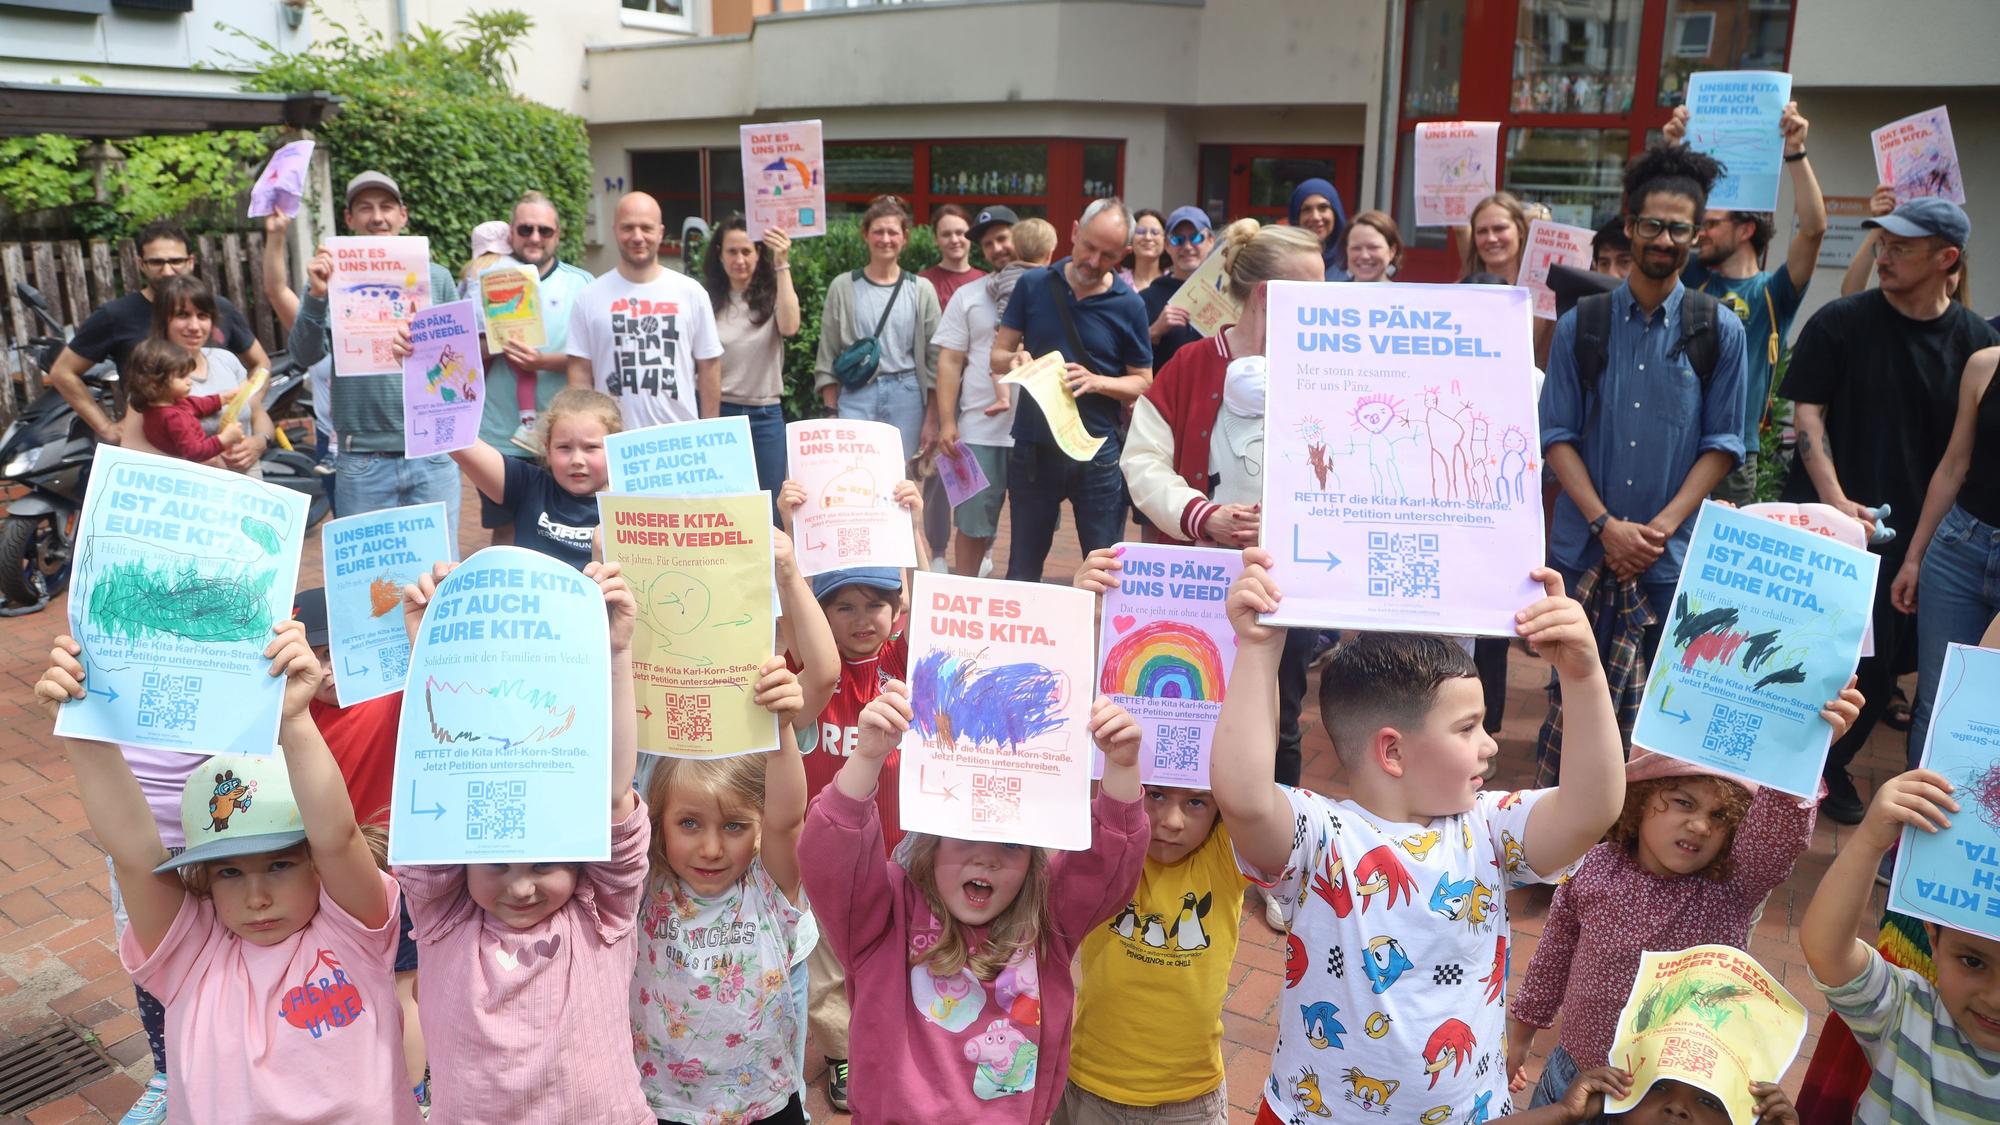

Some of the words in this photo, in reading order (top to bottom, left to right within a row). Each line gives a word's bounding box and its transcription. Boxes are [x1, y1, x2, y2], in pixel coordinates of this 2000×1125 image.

[1700, 83, 1748, 92] UNSERE
[1752, 82, 1779, 92] KITA
[1698, 94, 1718, 102] IST
[1720, 94, 1755, 103] AUCH
[1696, 106, 1728, 114] EURE
[752, 134, 773, 144] DAT
[776, 133, 789, 142] ES
[1424, 130, 1448, 139] UNS
[1880, 130, 1897, 142] DAT
[1900, 123, 1914, 134] ES
[752, 146, 774, 154] UNS
[1881, 139, 1902, 150] UNS
[1536, 228, 1556, 236] DAT
[1558, 231, 1570, 239] ES
[338, 248, 364, 258] DAT
[368, 248, 386, 258] ES
[339, 262, 368, 272] UNS
[371, 262, 406, 272] KITA.
[1298, 307, 1360, 327] UNS
[1369, 306, 1462, 334] PÄNZ,
[430, 325, 469, 340] VEEDEL.
[1297, 332, 1361, 353] UNS
[1368, 334, 1502, 358] VEEDEL.
[1297, 364, 1320, 376] Mer
[1323, 367, 1354, 378] stonn
[1358, 370, 1411, 378] zesamme.
[1297, 378, 1316, 390] För
[1320, 382, 1340, 392] uns
[800, 430, 832, 442] DAT
[836, 430, 856, 440] ES
[620, 436, 693, 460] UNSERE
[696, 432, 738, 448] KITA
[800, 443, 834, 456] UNS
[838, 443, 880, 454] KITA.
[622, 460, 650, 476] IST
[656, 452, 707, 470] AUCH
[626, 474, 673, 492] EURE
[676, 467, 724, 485] KITA.
[116, 468, 226, 498] UNSERE
[232, 490, 288, 522] KITA
[1294, 492, 1346, 504] RETTET
[1349, 494, 1368, 504] die
[1372, 494, 1397, 506] Kita
[1400, 496, 1512, 512] Karl-Korn-Straße.
[110, 491, 158, 514] IST
[160, 500, 238, 528] AUCH
[1308, 506, 1340, 518] Jetzt
[1343, 508, 1392, 520] Petition
[1394, 512, 1495, 524] unterschreiben.
[105, 514, 182, 541] EURE
[616, 512, 680, 528] UNSERE
[684, 513, 734, 528] KITA.
[1790, 515, 1810, 526] ES
[334, 522, 395, 545] UNSERE
[398, 516, 436, 532] KITA
[616, 530, 669, 546] UNSER
[672, 531, 754, 547] VEEDEL.
[336, 546, 358, 562] IST
[362, 537, 407, 554] AUCH
[1713, 523, 1804, 564] UNSERE
[1808, 552, 1858, 580] KITA
[336, 556, 376, 576] EURE
[379, 552, 422, 568] KITA.
[656, 554, 671, 566] Für
[672, 556, 728, 568] Generationen.
[1706, 544, 1745, 566] IST
[1746, 556, 1814, 588] AUCH
[1123, 560, 1166, 578] UNS
[1170, 560, 1231, 585] PÄNZ,
[441, 568, 524, 598] UNSERE
[530, 571, 586, 596] KITA
[1122, 580, 1164, 598] UNS
[1700, 564, 1763, 595] EURE
[1766, 582, 1825, 614] KITA.
[434, 597, 462, 621] IST
[466, 594, 540, 615] AUCH
[932, 592, 982, 615] DAT
[988, 598, 1022, 618] ES
[1120, 604, 1134, 613] Dat
[1180, 606, 1199, 618] ohne
[1201, 608, 1212, 619] dat
[1696, 588, 1718, 602] Helft
[1737, 600, 1748, 610] sie
[1750, 606, 1760, 614] zu
[1762, 608, 1796, 625] erhalten.
[428, 620, 488, 645] EURE
[490, 620, 561, 640] KITA.
[930, 616, 984, 640] UNS
[990, 623, 1056, 646] KITA.
[86, 634, 132, 646] RETTET
[134, 637, 148, 649] die
[152, 638, 174, 652] Kita
[96, 647, 122, 659] Jetzt
[125, 650, 166, 662] Petition
[168, 654, 252, 672] unterschreiben.
[424, 652, 462, 666] Solidarität
[464, 652, 478, 664] mit
[481, 650, 498, 663] den
[501, 650, 542, 664] Familien
[544, 652, 557, 664] im
[654, 665, 665, 674] die
[666, 666, 682, 675] Kita
[682, 664, 760, 676] Karl-Korn-Straße.
[632, 673, 650, 682] Jetzt
[651, 674, 679, 685] Petition
[680, 676, 748, 686] unterschreiben.
[1710, 674, 1724, 684] die
[1725, 678, 1744, 690] Kita
[1114, 696, 1146, 705] RETTET
[1162, 700, 1178, 708] Kita
[1678, 676, 1701, 689] Jetzt
[1703, 682, 1737, 699] Petition
[1738, 694, 1806, 721] unterschreiben.
[1143, 708, 1174, 717] Petition
[414, 749, 452, 760] RETTET
[454, 748, 470, 758] die
[472, 747, 493, 758] Kita
[495, 746, 590, 758] Karl-Korn-Straße.
[961, 744, 974, 754] die
[976, 744, 994, 755] Kita
[423, 762, 447, 772] Jetzt
[449, 760, 488, 770] Petition
[490, 760, 574, 770] unterschreiben.
[932, 752, 954, 762] Jetzt
[956, 754, 990, 766] Petition
[992, 758, 1061, 772] unterschreiben.
[1916, 878, 1979, 913] KITA
[1656, 959, 1714, 980] UNSER
[1658, 951, 1729, 970] UNSERE
